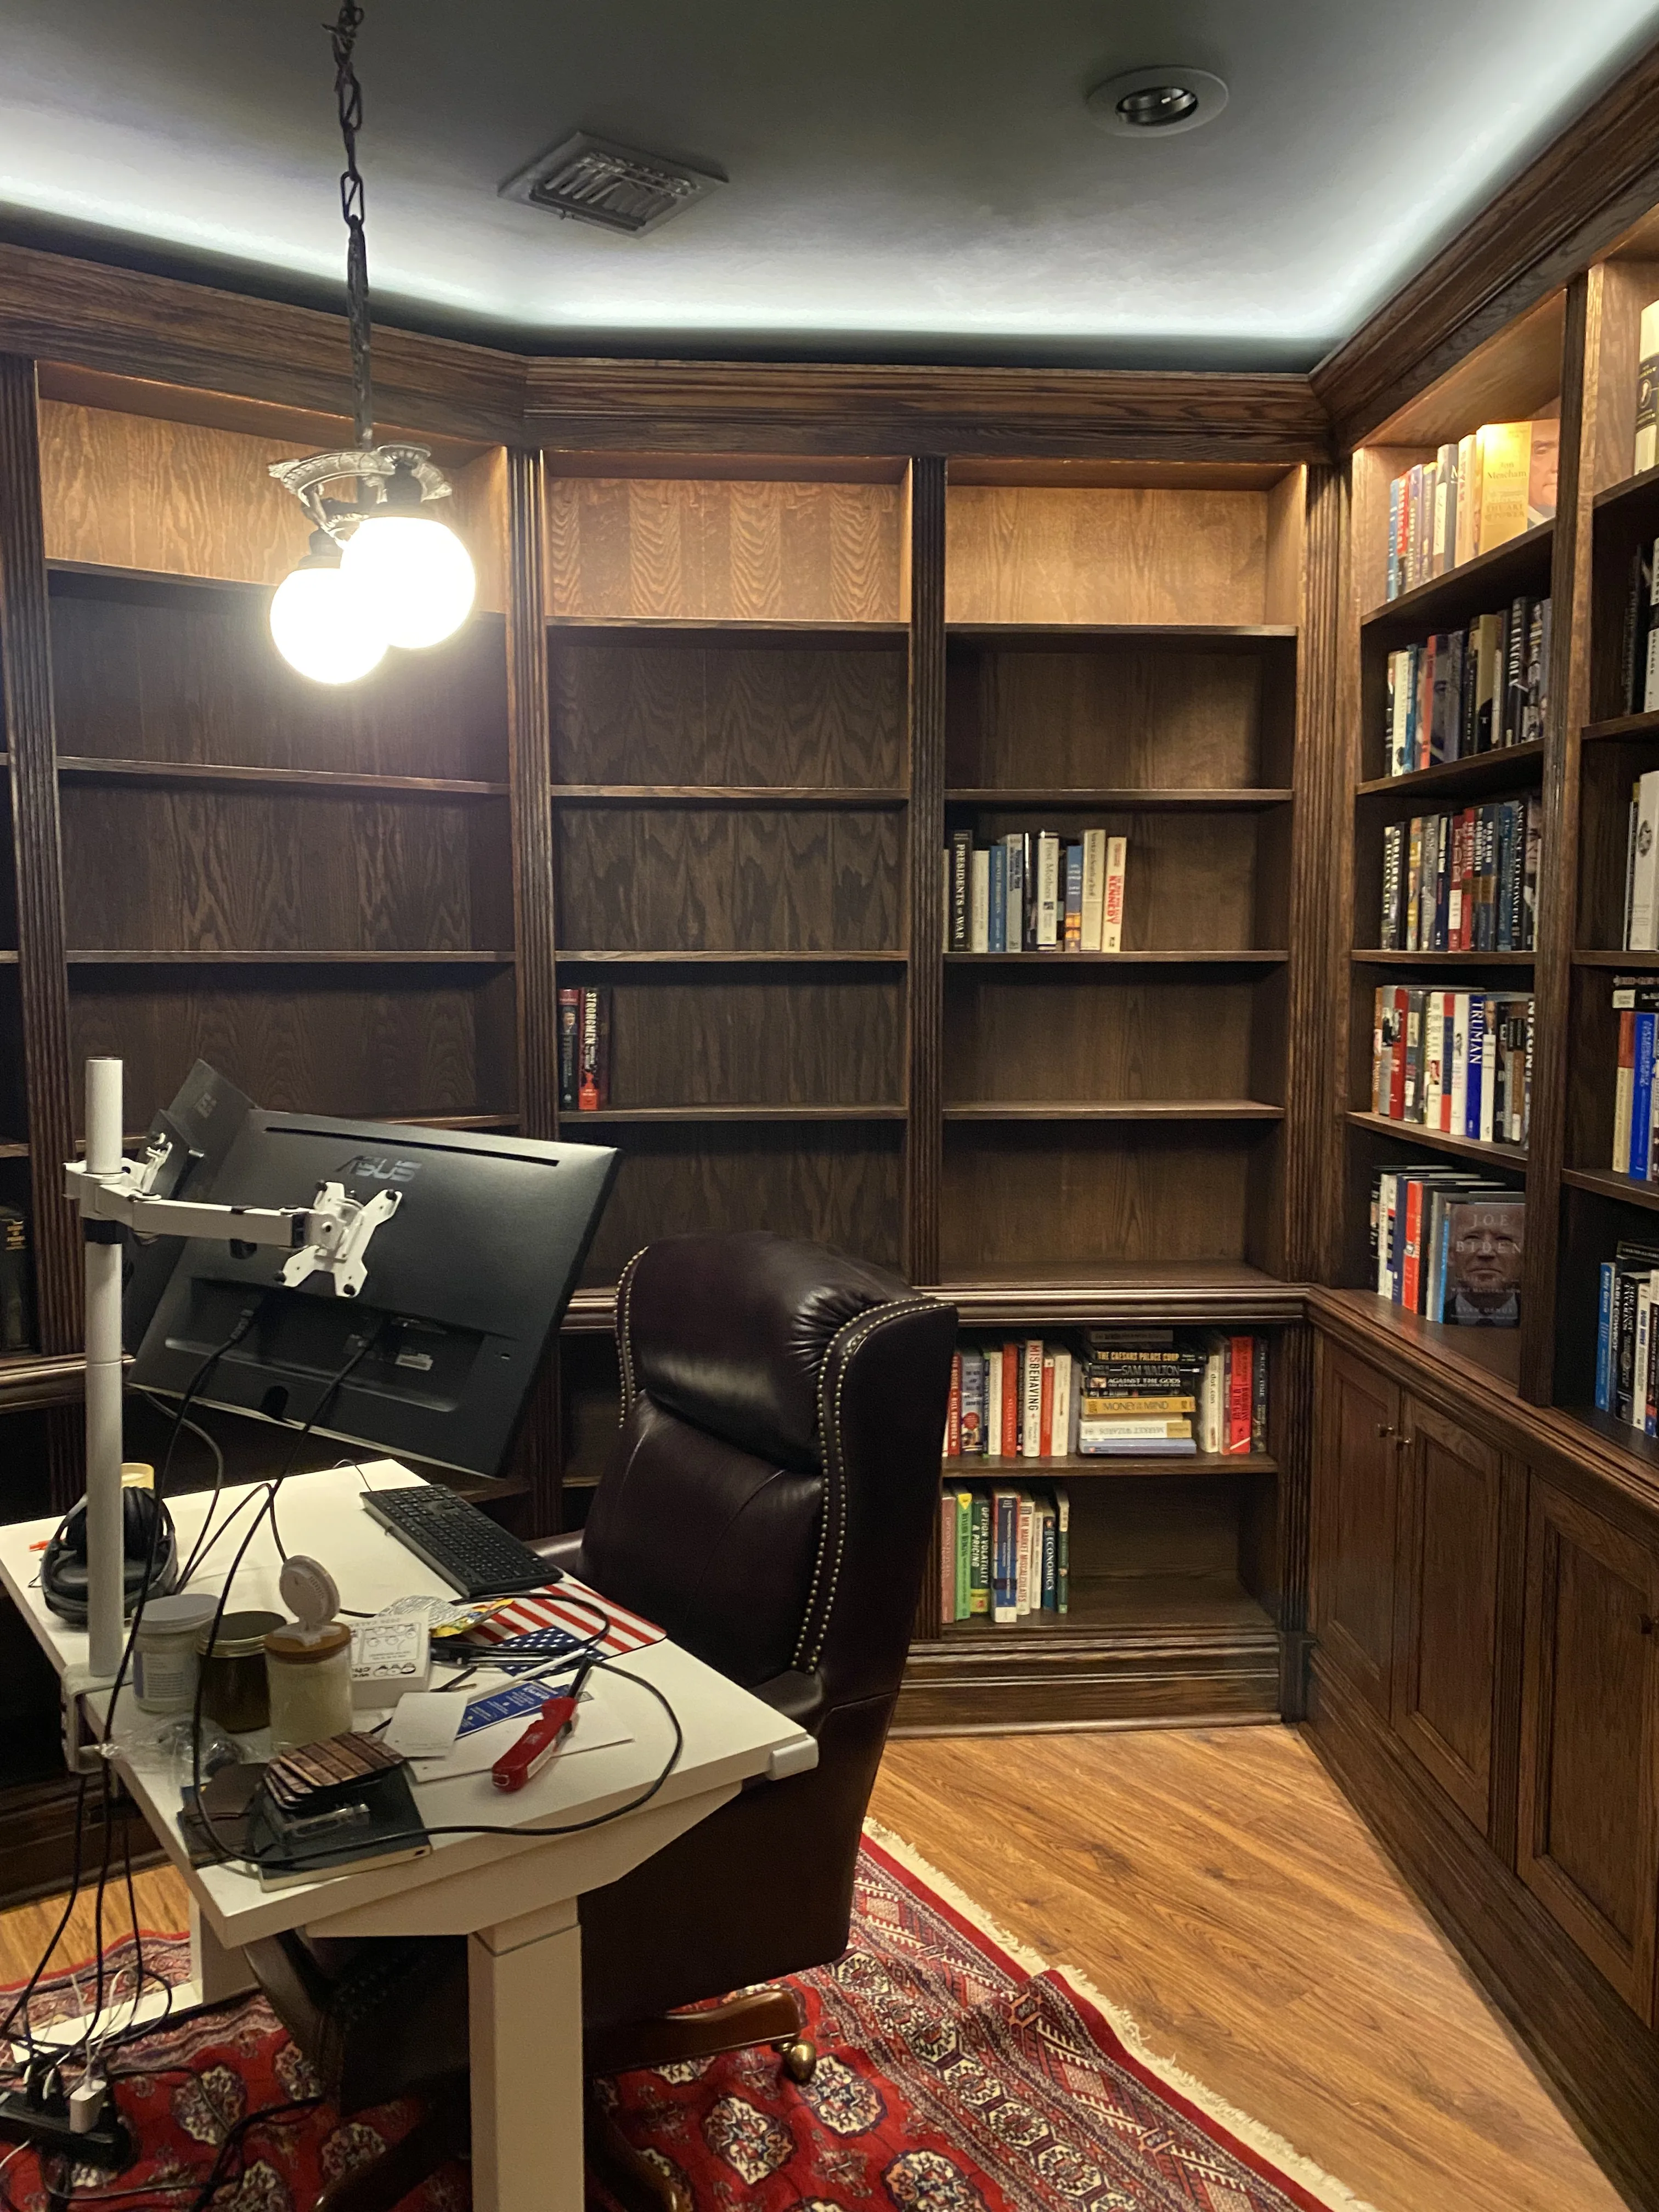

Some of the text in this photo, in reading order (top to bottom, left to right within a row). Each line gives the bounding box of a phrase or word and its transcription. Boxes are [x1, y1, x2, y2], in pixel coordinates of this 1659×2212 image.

[1487, 469, 1527, 480] Meacham
[956, 844, 966, 905] PRESIDENTS
[1046, 842, 1055, 899] First Mothers
[1106, 875, 1117, 924] KENNEDY
[955, 916, 964, 939] WAR
[585, 992, 597, 1044] STRONGMEN
[1469, 1001, 1484, 1064] TRUMAN
[1526, 1001, 1535, 1068] NIXON
[334, 1155, 422, 1182] ASUS
[1472, 1214, 1511, 1228] JOE
[1455, 1240, 1521, 1254] BIDEN
[1612, 1308, 1621, 1352] COWBOY
[1029, 1345, 1041, 1410] MISBEHAVING
[1097, 1351, 1109, 1360] THE
[1121, 1365, 1142, 1375] SAM
[1143, 1365, 1181, 1376] WALTON
[1103, 1402, 1135, 1411] MONEY
[1143, 1401, 1169, 1409] MIND
[972, 1534, 980, 1567] PRICING
[980, 1506, 989, 1585] OPTION VOLATILITY
[1020, 1528, 1030, 1553] MARKET
[1018, 1554, 1029, 1602] MISCALCULATES
[1045, 1537, 1054, 1591] ECONOMICS
